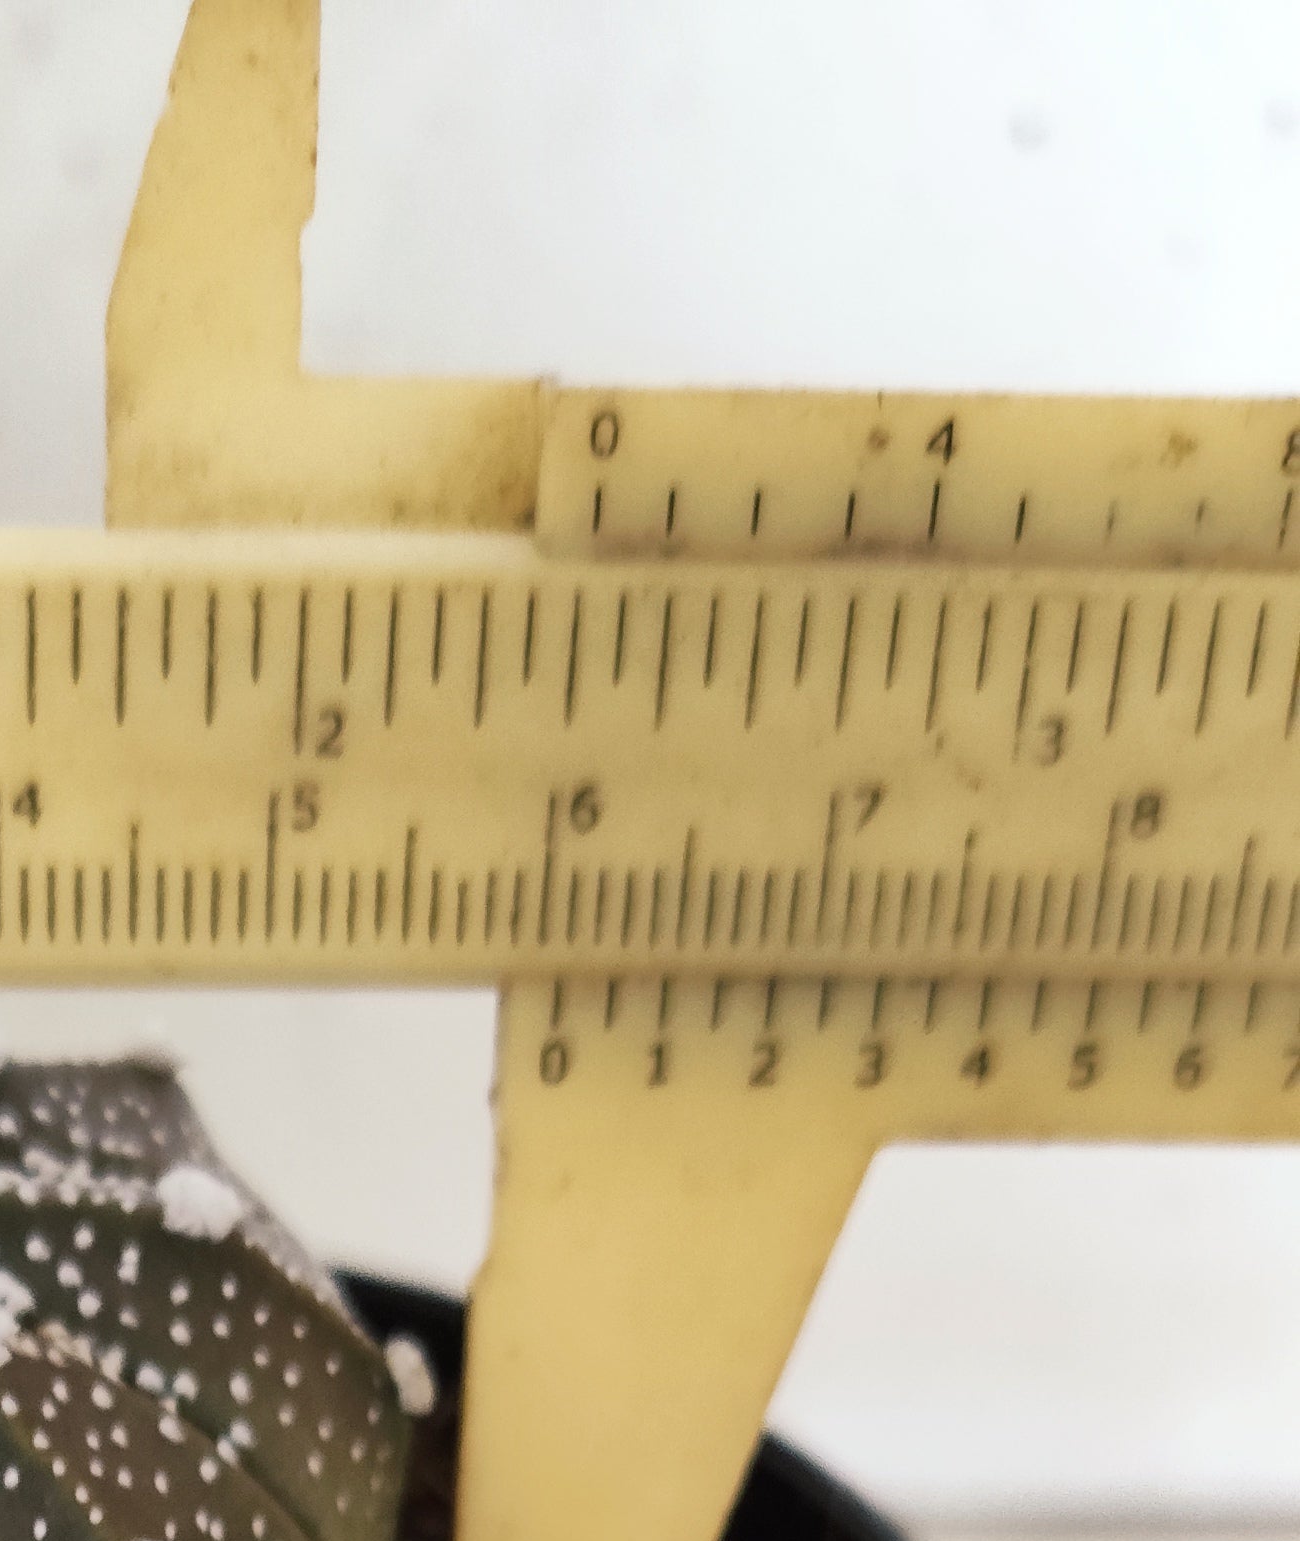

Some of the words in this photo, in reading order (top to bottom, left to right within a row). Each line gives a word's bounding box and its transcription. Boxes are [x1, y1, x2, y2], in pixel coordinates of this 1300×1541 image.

[589, 410, 620, 461] 0
[925, 413, 957, 466] 4
[315, 706, 347, 757] 2
[1038, 713, 1070, 766] 3
[11, 780, 41, 828] 4
[293, 782, 321, 832] 5
[568, 781, 601, 834] 6
[854, 783, 888, 834] 7
[1130, 790, 1166, 840] 8
[539, 1042, 570, 1088] 0
[646, 1043, 668, 1089] 1
[747, 1044, 781, 1089] 2
[855, 1044, 888, 1090] 3
[959, 1043, 994, 1084] 4
[1066, 1044, 1100, 1091] 5
[1172, 1043, 1206, 1092] 6
